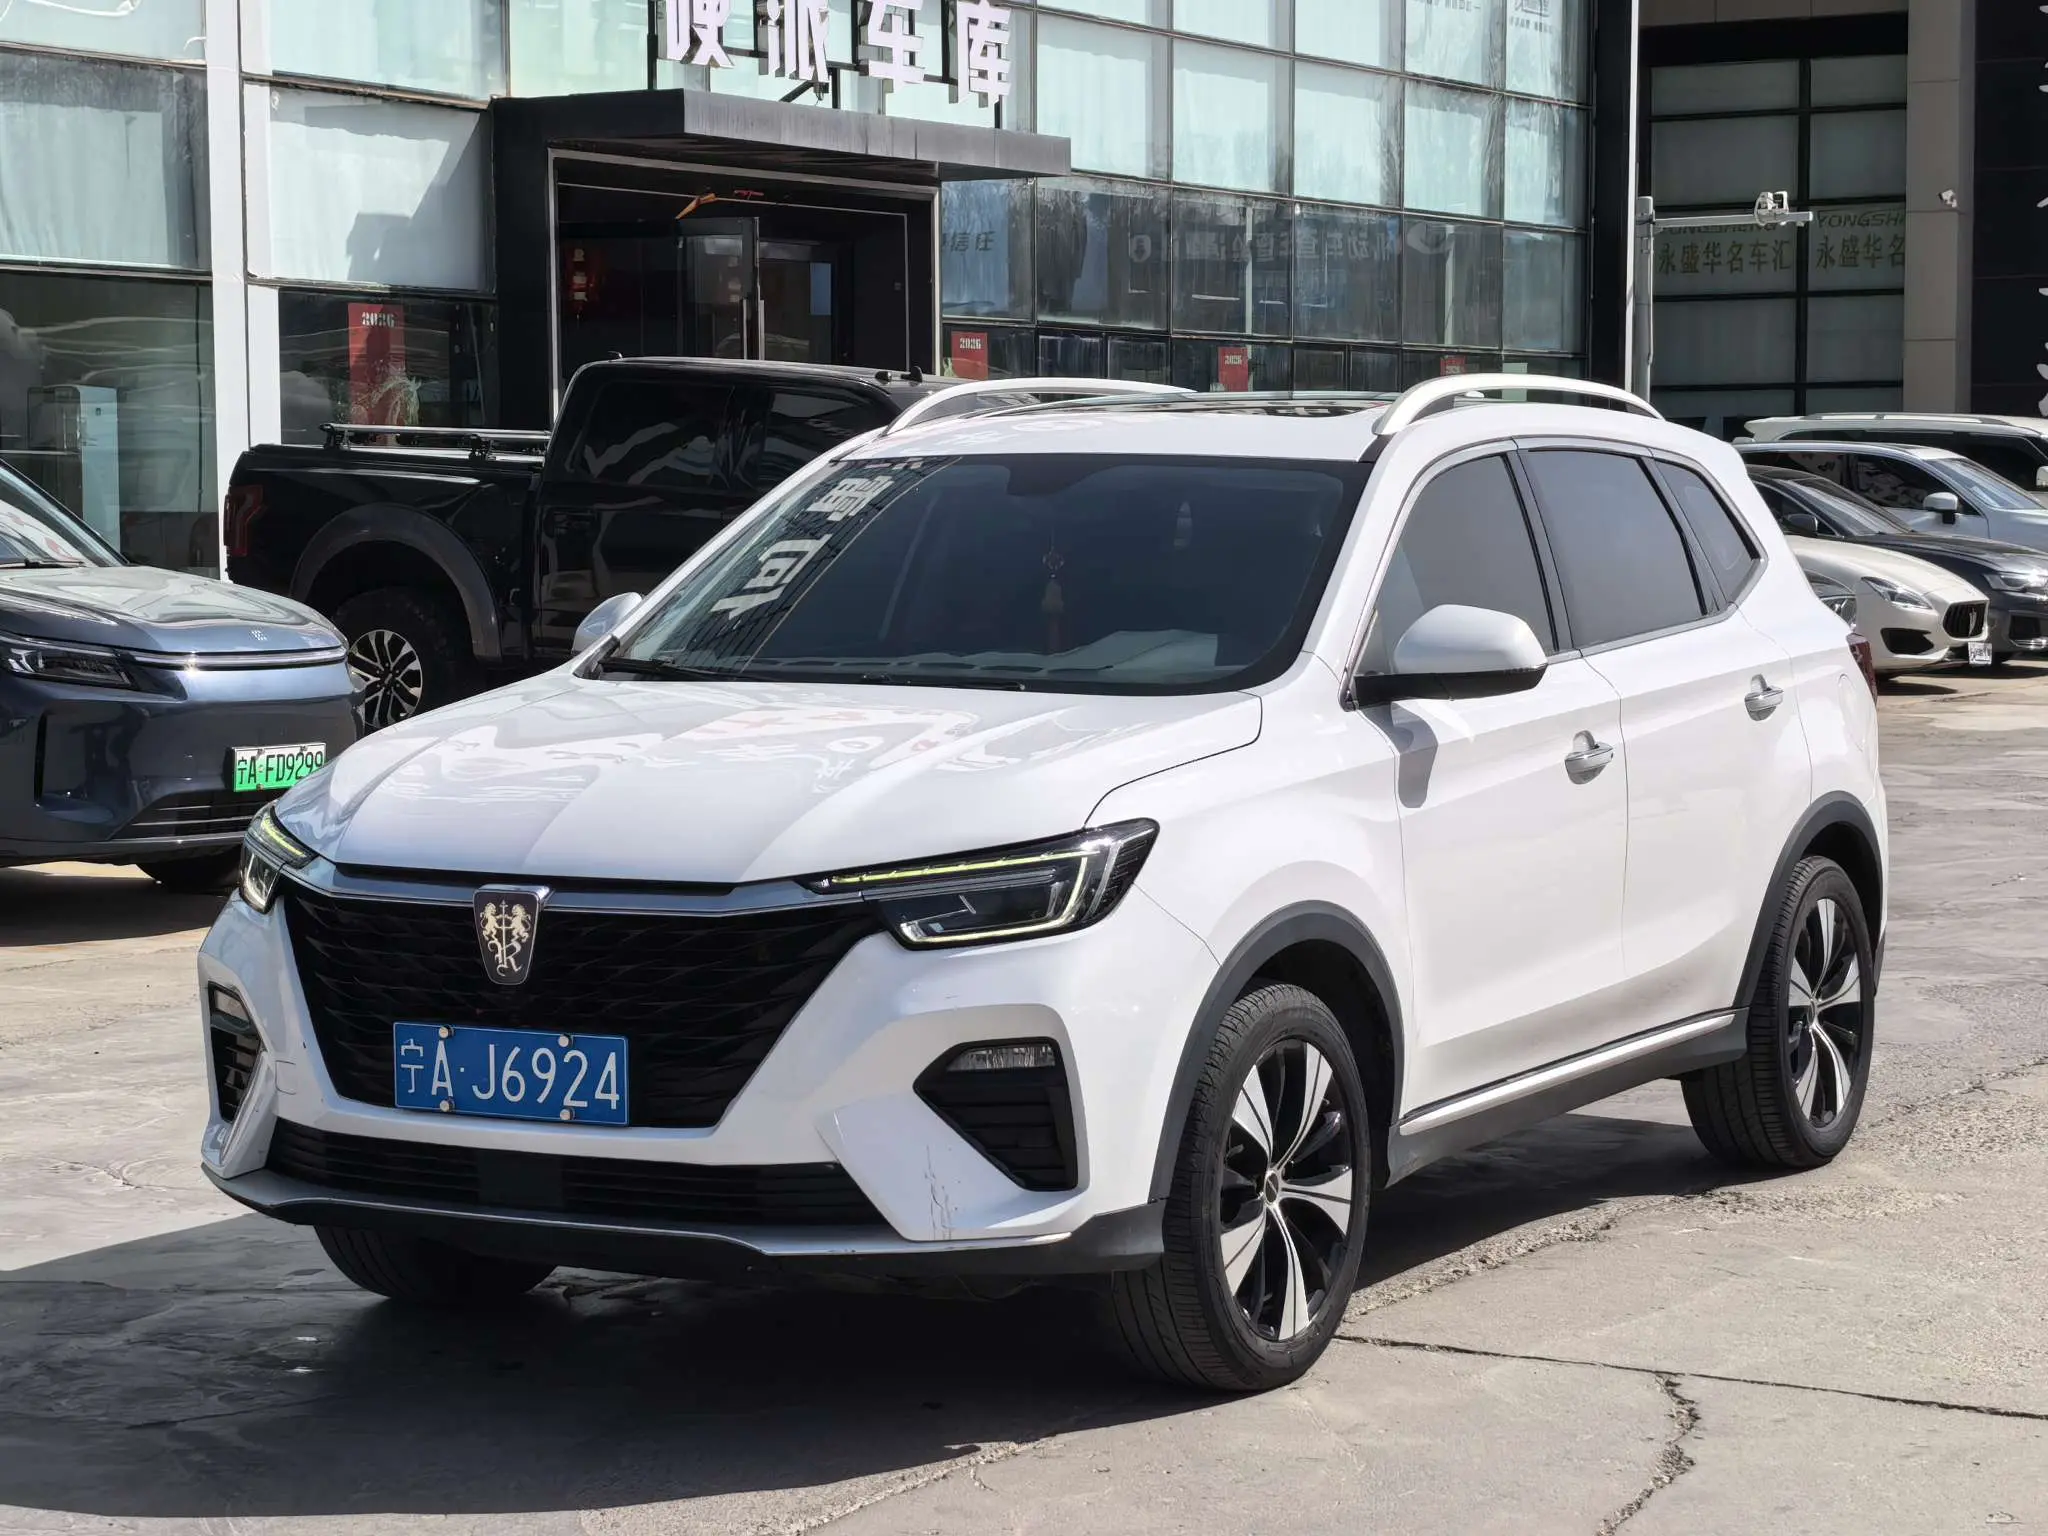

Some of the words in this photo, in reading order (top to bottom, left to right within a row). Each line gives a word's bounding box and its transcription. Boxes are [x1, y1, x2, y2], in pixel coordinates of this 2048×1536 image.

[1659, 239, 1791, 275] 永盛华名车汇
[361, 311, 395, 328] 2026
[959, 337, 982, 350] 2026
[400, 1038, 620, 1111] 宁A·J6924
